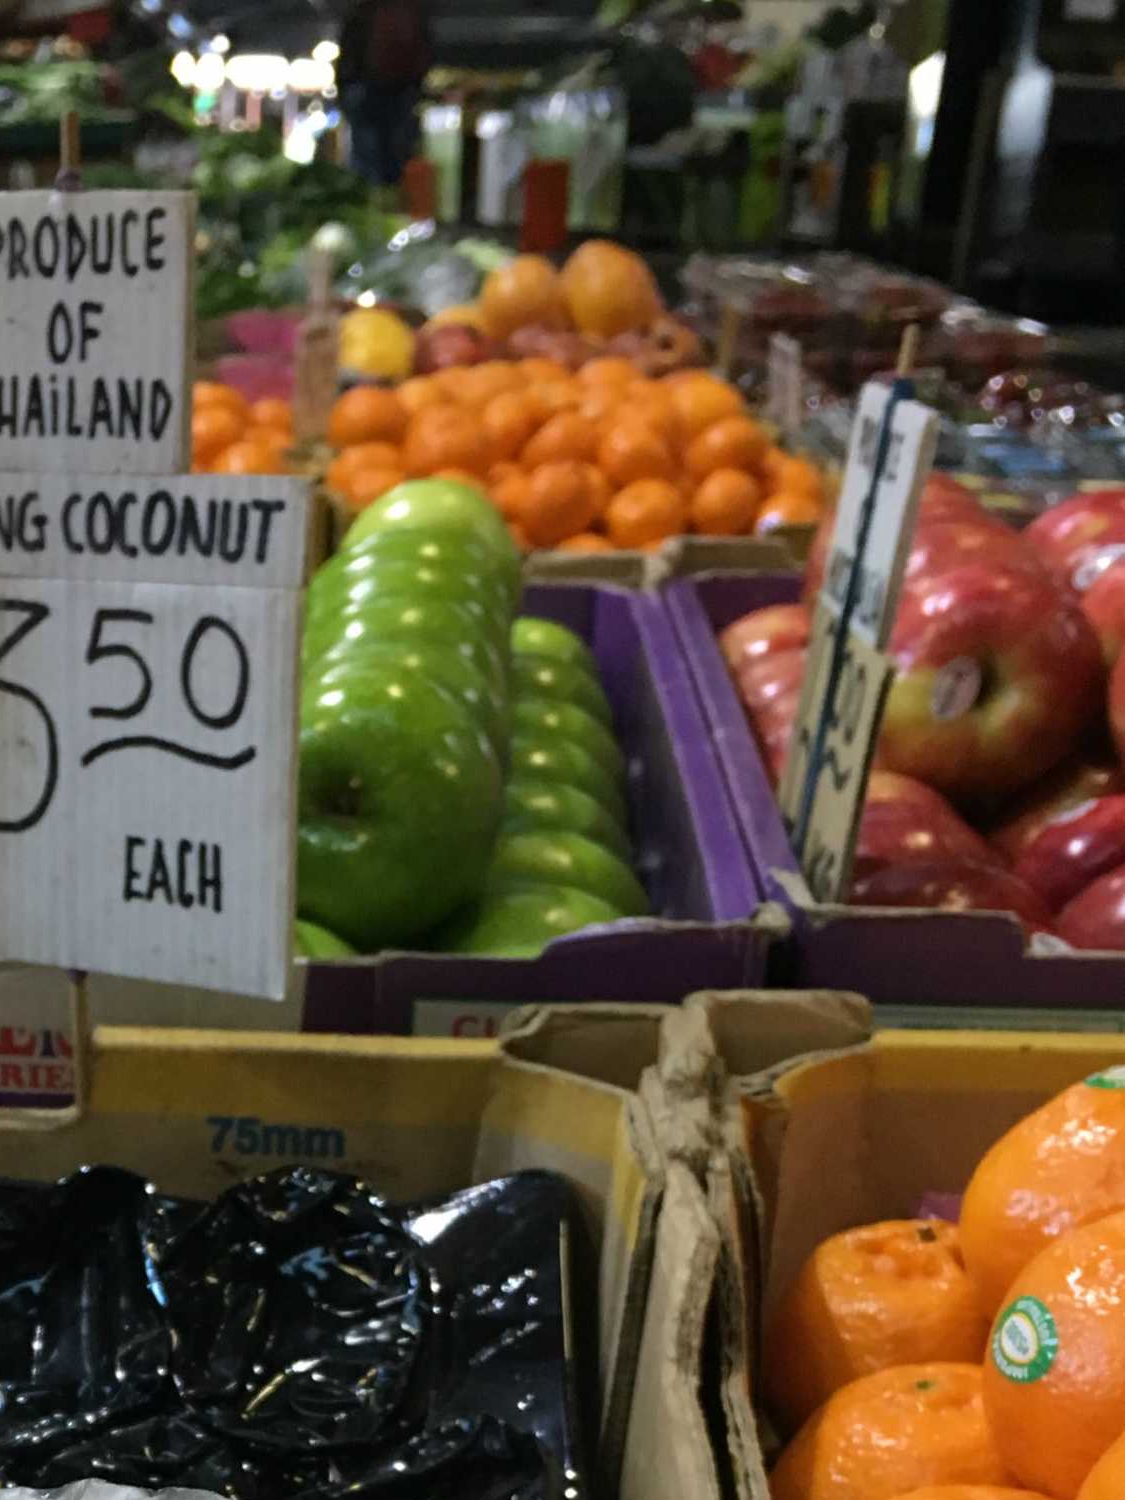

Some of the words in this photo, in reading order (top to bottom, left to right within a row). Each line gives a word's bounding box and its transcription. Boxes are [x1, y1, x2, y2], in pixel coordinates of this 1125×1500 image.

[46, 300, 105, 364] OF
[61, 490, 286, 564] COCONUT
[123, 835, 223, 913] EACH
[206, 1115, 347, 1159] 75mm
